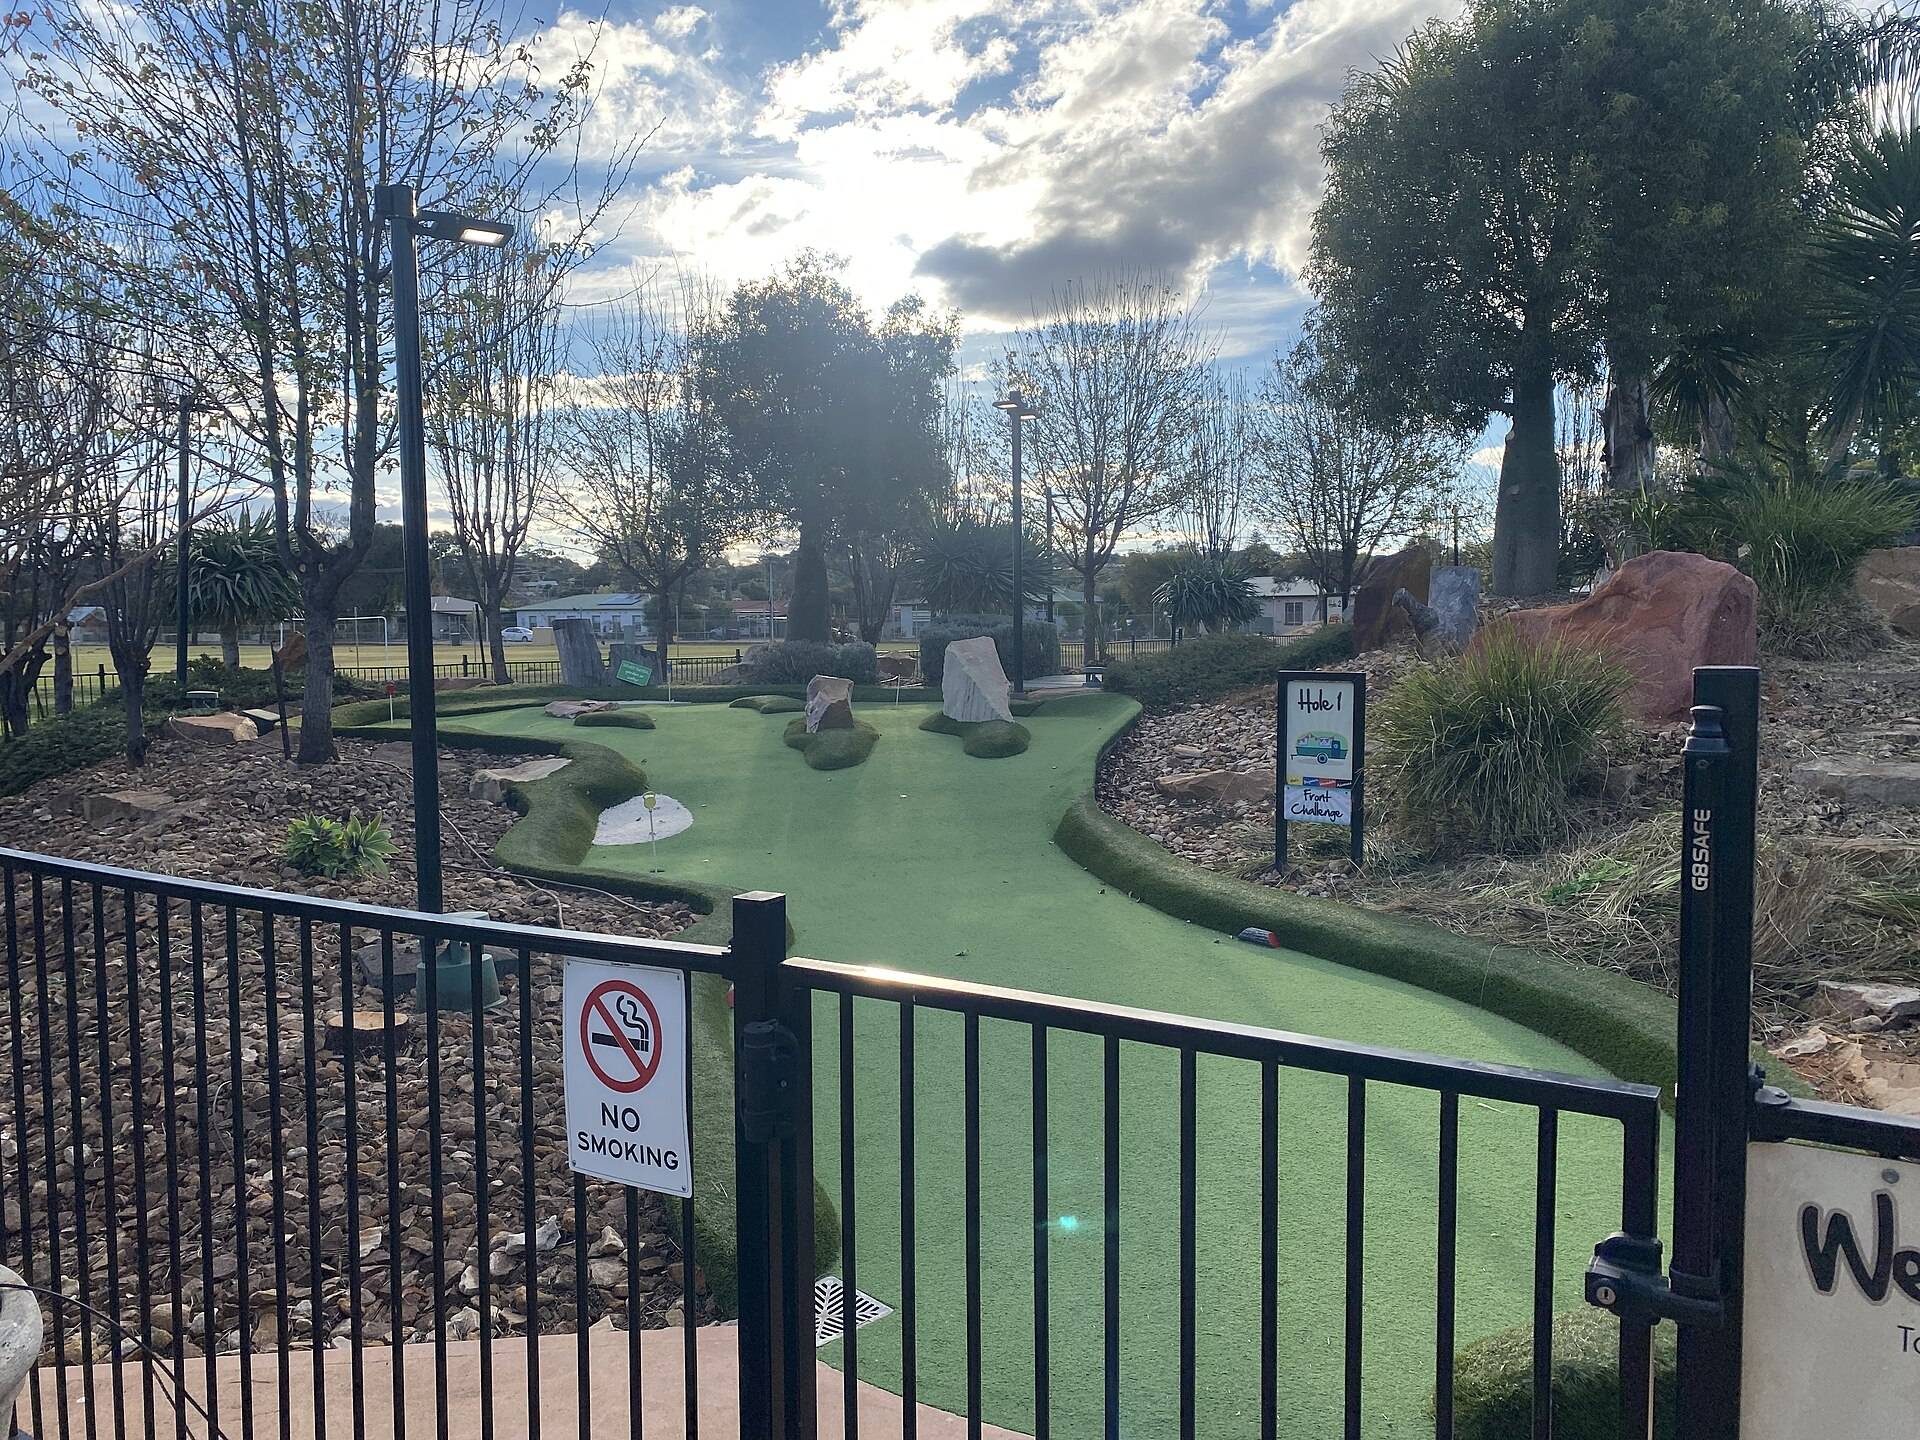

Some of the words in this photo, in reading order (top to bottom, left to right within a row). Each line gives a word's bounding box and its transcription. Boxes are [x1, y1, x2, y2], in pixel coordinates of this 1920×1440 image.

[1297, 688, 1334, 713] Hole
[1337, 691, 1342, 711] 1
[1303, 789, 1332, 803] Front
[1291, 802, 1343, 822] Challenge
[601, 1102, 641, 1133] NO
[577, 1131, 679, 1171] SMOKING
